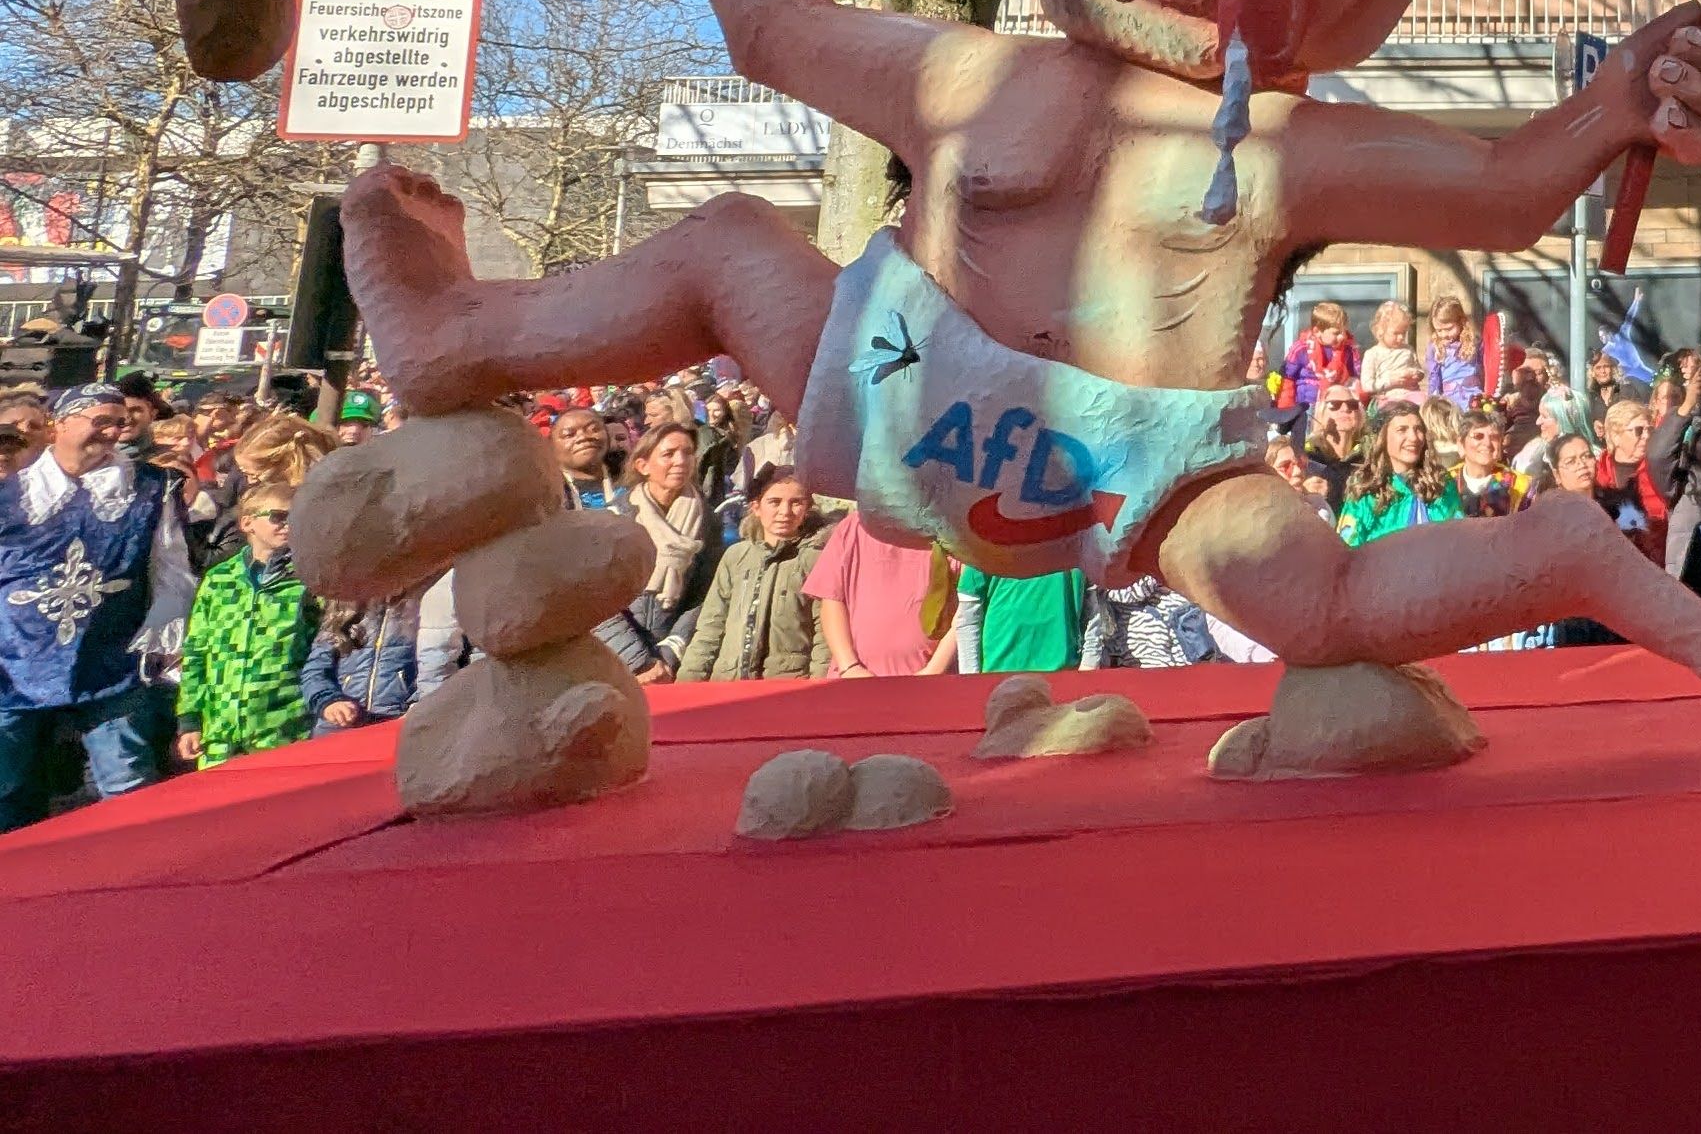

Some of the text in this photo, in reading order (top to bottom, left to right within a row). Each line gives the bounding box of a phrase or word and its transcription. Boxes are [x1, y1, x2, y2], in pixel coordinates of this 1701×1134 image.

[309, 0, 463, 20] Feuersicheitszone
[319, 26, 450, 48] verkehrswidrig
[333, 48, 430, 68] abgestellte
[298, 68, 458, 90] Fahrzeuge werden
[317, 91, 435, 114] abgeschleppt
[901, 400, 1095, 506] AfD
